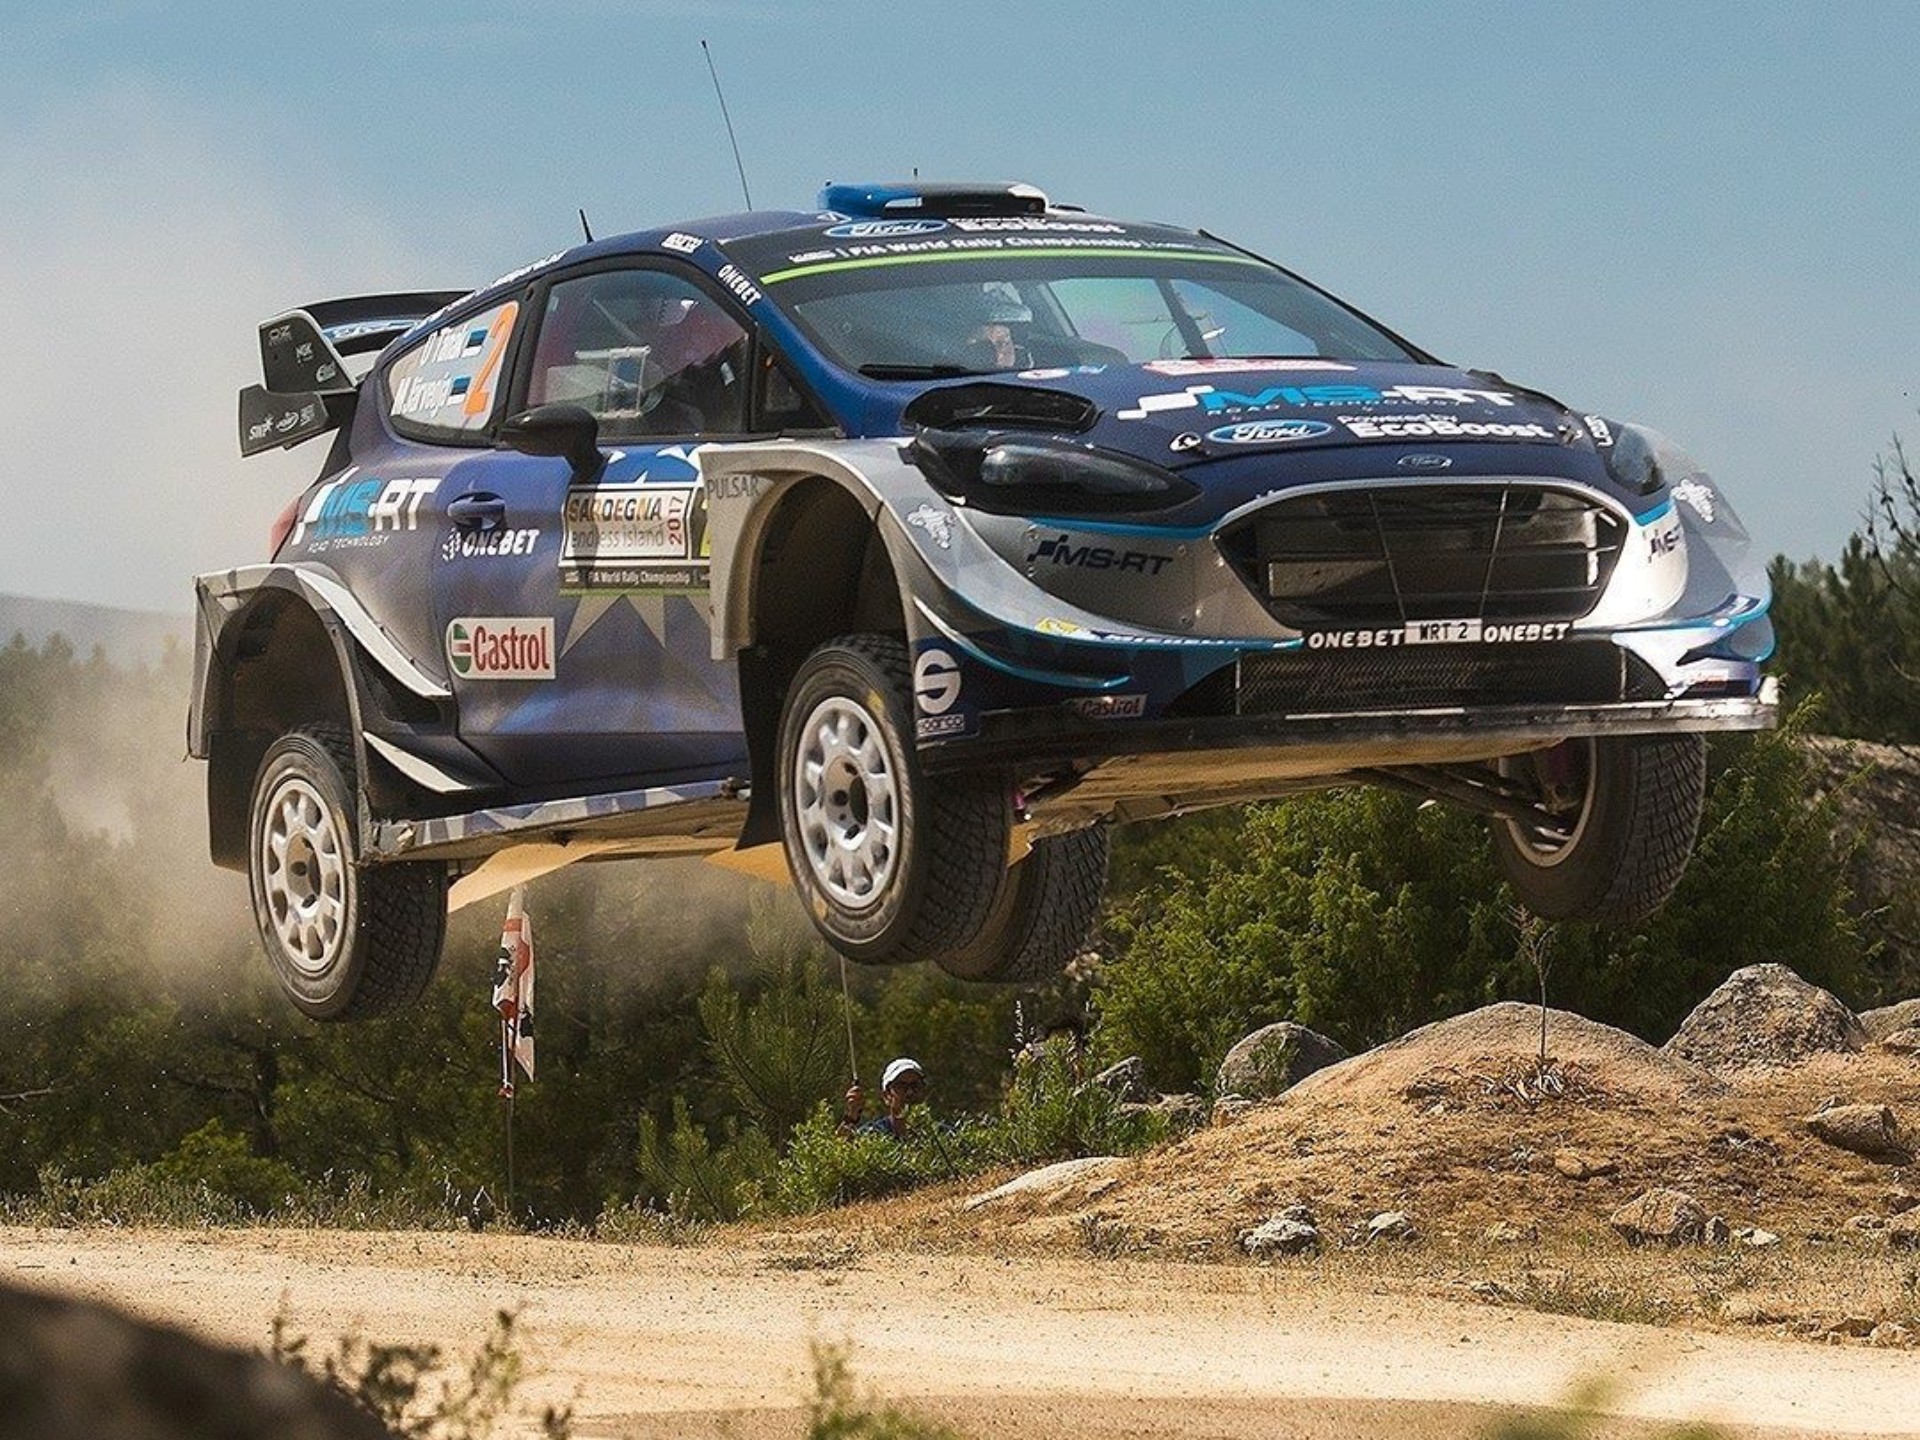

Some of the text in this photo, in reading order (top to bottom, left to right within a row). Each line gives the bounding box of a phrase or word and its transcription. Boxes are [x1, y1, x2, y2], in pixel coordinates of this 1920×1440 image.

[851, 222, 928, 236] Ford
[849, 245, 888, 257] FIA
[887, 240, 949, 252] World
[951, 237, 1003, 248] Rally
[1005, 236, 1142, 248] Championship
[717, 264, 762, 306] ONEBET
[463, 300, 519, 416] 2
[1199, 385, 1515, 411] MS-RT
[1232, 423, 1312, 441] Ford
[1347, 421, 1555, 438] EcoBoost
[707, 475, 760, 499] PULSAR
[314, 477, 441, 538] MS-RT
[567, 497, 663, 523] SARDEGNA
[667, 496, 684, 545] 2017
[333, 534, 390, 549] TECHNOLOGY
[462, 529, 540, 557] ONEBET
[571, 524, 664, 549] endless island
[1053, 545, 1174, 575] MS-RT
[621, 570, 640, 585] Rally
[640, 570, 691, 585] Championship
[1308, 628, 1405, 649] ONEBET
[1419, 621, 1468, 641] WRT 2
[1484, 622, 1571, 643] ONEBET
[473, 625, 550, 671] Castrol
